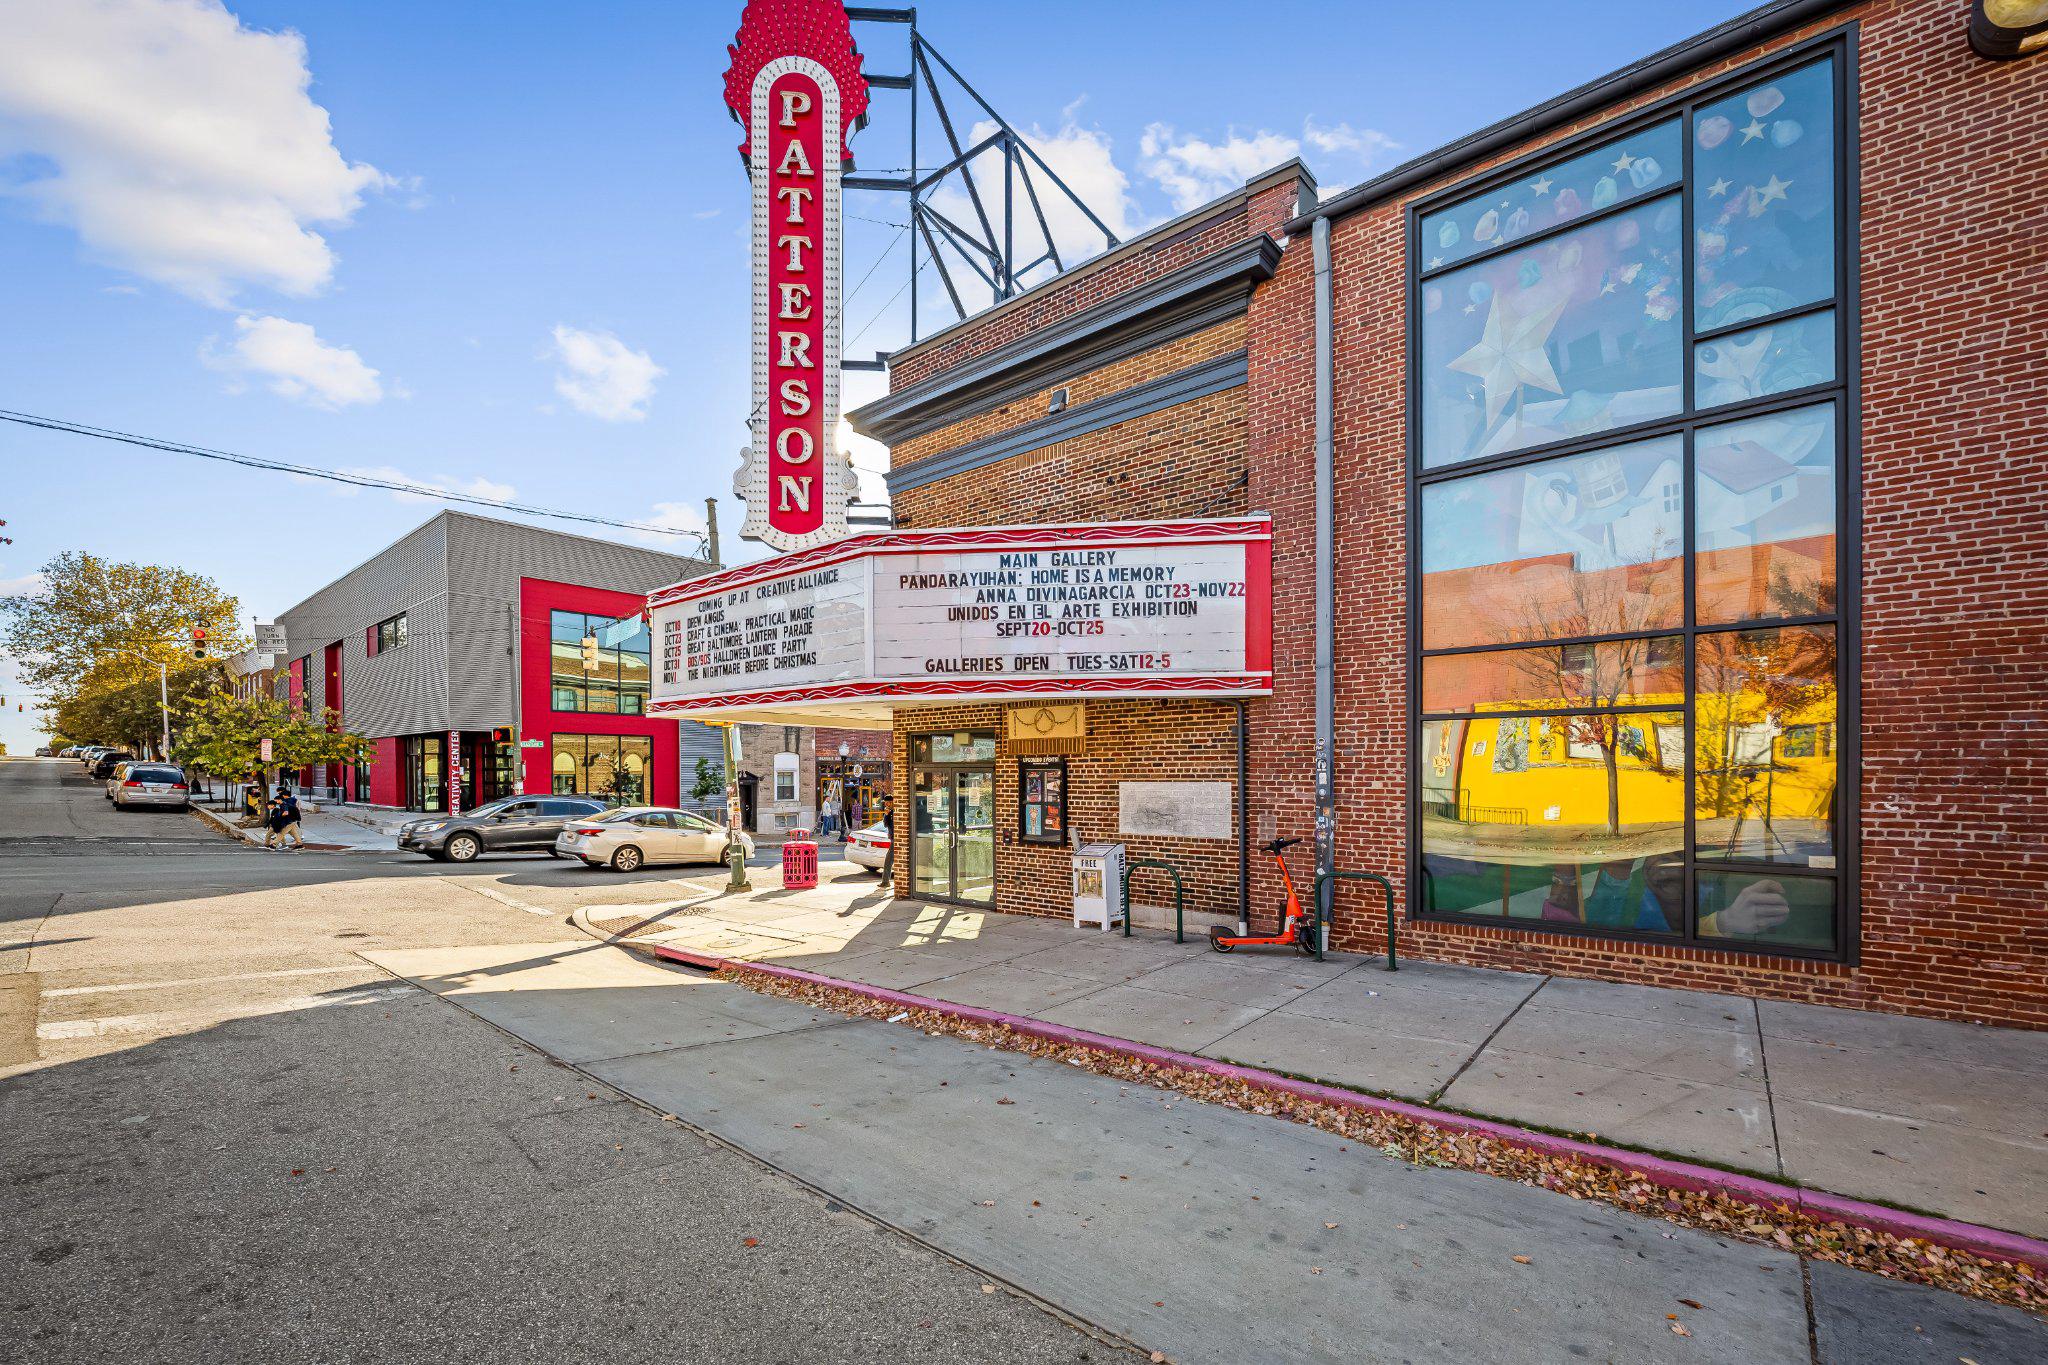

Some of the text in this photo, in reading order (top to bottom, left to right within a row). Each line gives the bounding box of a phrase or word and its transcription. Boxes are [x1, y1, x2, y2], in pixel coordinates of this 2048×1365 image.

[777, 90, 815, 513] PATTERSON
[1000, 551, 1116, 568] MAIN GALLERY
[900, 566, 1175, 589] PANDARAYUHAN: HOME IS A MEMORY
[699, 569, 838, 612] COMING UP AT CREATIVE ALLIANCE
[976, 582, 1245, 603] ANNA DIVINAGARCIA OCT23-NOV22
[687, 616, 701, 629] DREW
[704, 610, 724, 625] ANGUS
[948, 606, 999, 621] UNIDOS
[1008, 605, 1026, 619] EN
[1062, 603, 1100, 618] ARTE
[1112, 600, 1197, 617] EXHIBITION
[665, 606, 814, 645] OCT23 CRAFT & CINEMA: PRACTICAL MAGIC
[996, 620, 1104, 636] SEPT20-OCT25
[664, 622, 812, 658] OCT25 GREAT BALTIMORE LANTERN PARADE
[664, 659, 680, 670] OCT31
[714, 647, 750, 663] HALLOWEEN
[753, 643, 776, 657] DANCE
[782, 638, 806, 653] PARTY
[925, 654, 1170, 673] GALLERIES OPEN TUES-SAT12-5
[663, 652, 816, 683] NOV1 THE NIGHTMARE BEFORE CHRISTMAS
[451, 731, 460, 816] REATIVITY CENTER
[1081, 859, 1097, 867] FREE
